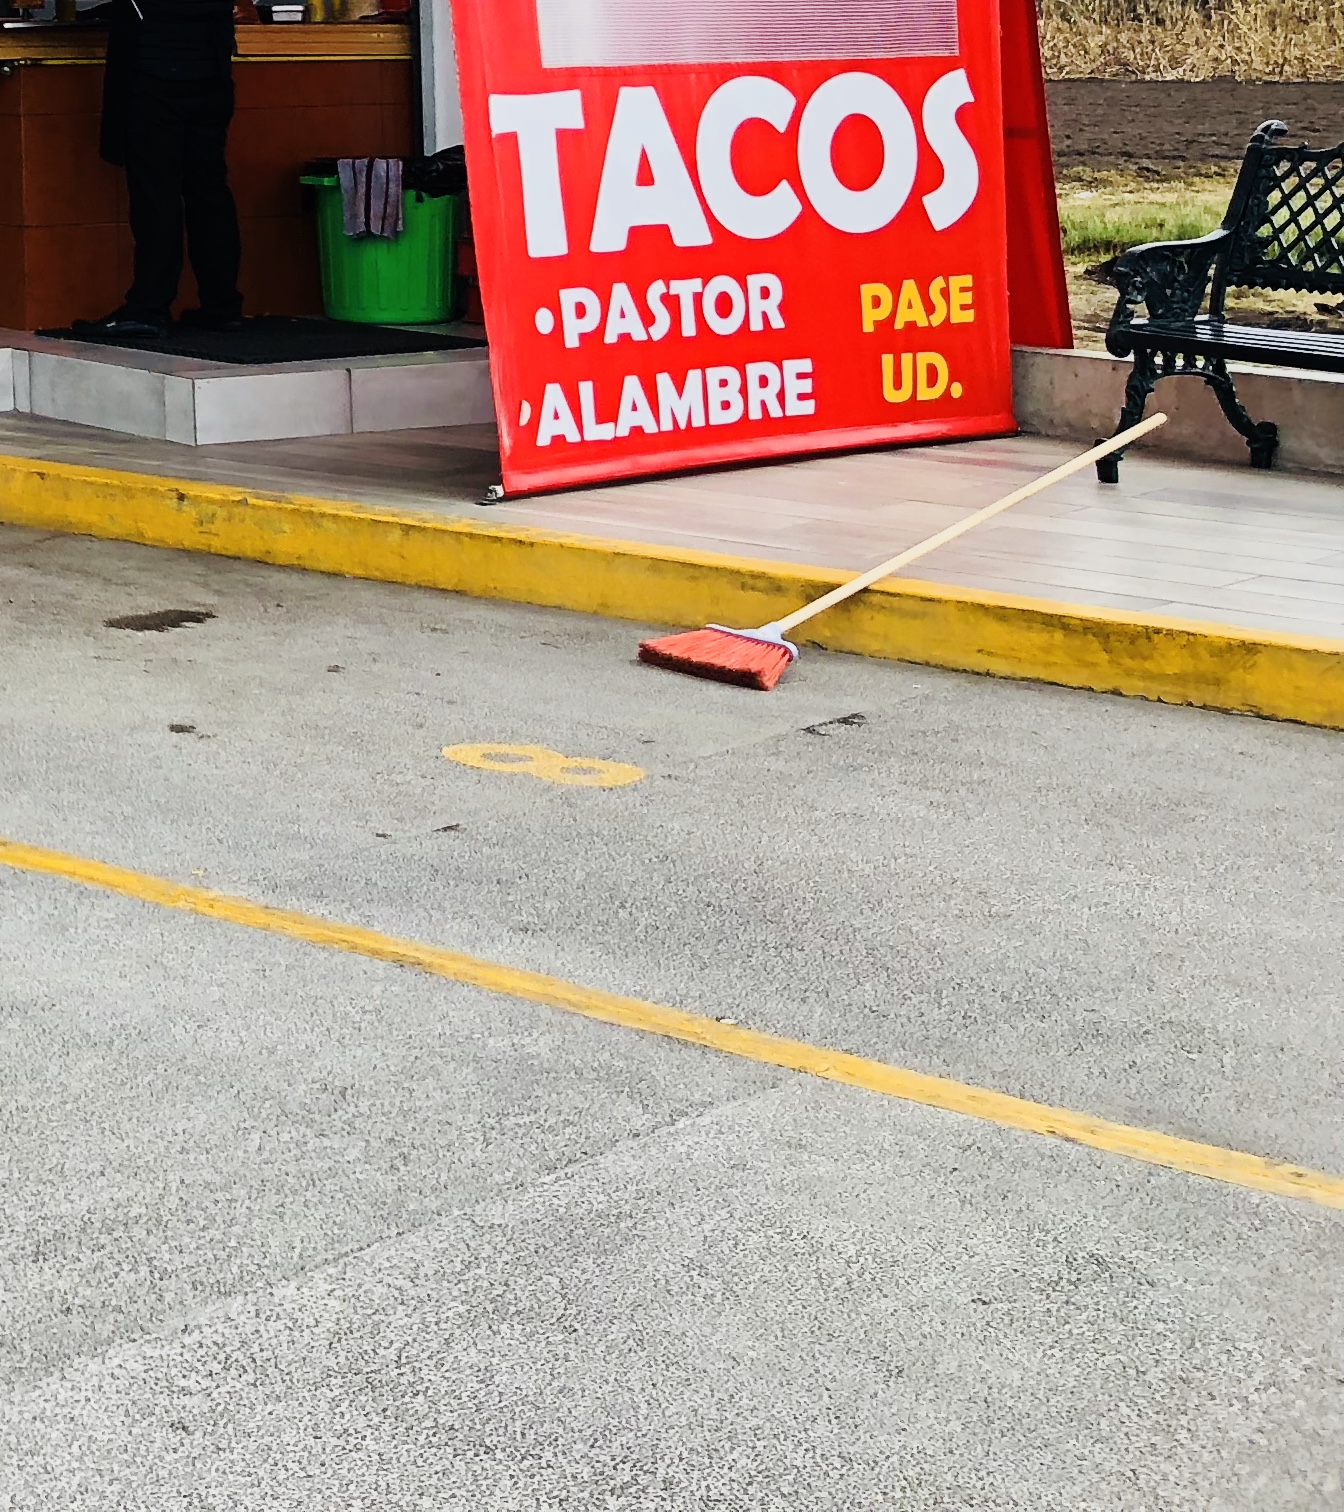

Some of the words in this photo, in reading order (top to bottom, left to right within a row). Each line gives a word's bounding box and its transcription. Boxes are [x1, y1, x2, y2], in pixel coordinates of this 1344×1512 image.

[488, 67, 980, 258] TACOS
[860, 274, 976, 333] PASE
[881, 351, 963, 404] UD.
